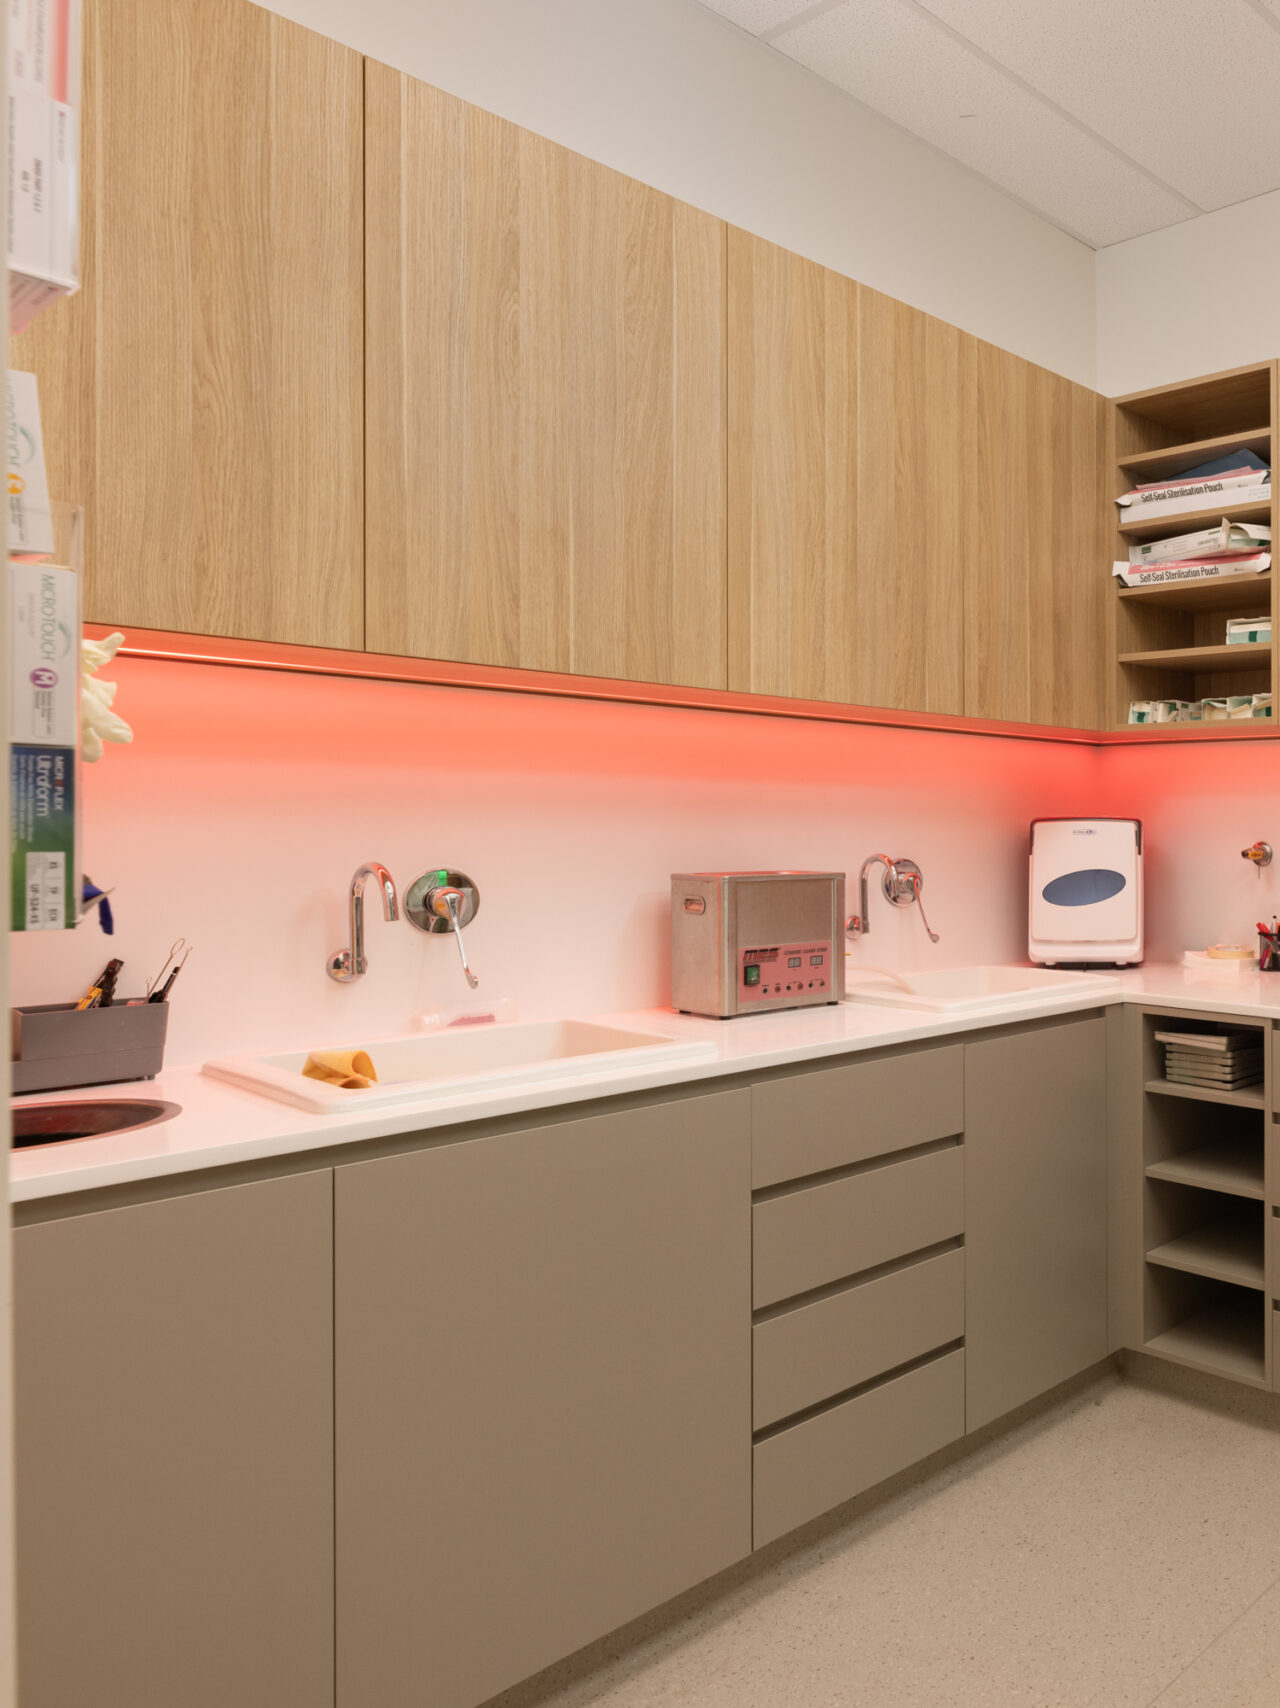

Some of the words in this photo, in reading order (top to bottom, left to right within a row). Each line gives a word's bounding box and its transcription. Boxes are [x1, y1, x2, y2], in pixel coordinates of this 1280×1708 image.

[1167, 484, 1203, 499] Sterilisation
[1204, 482, 1224, 493] Pouch
[1165, 568, 1201, 581] Sterilisation
[1201, 565, 1220, 577] Pouch
[35, 755, 52, 818] Ultraform
